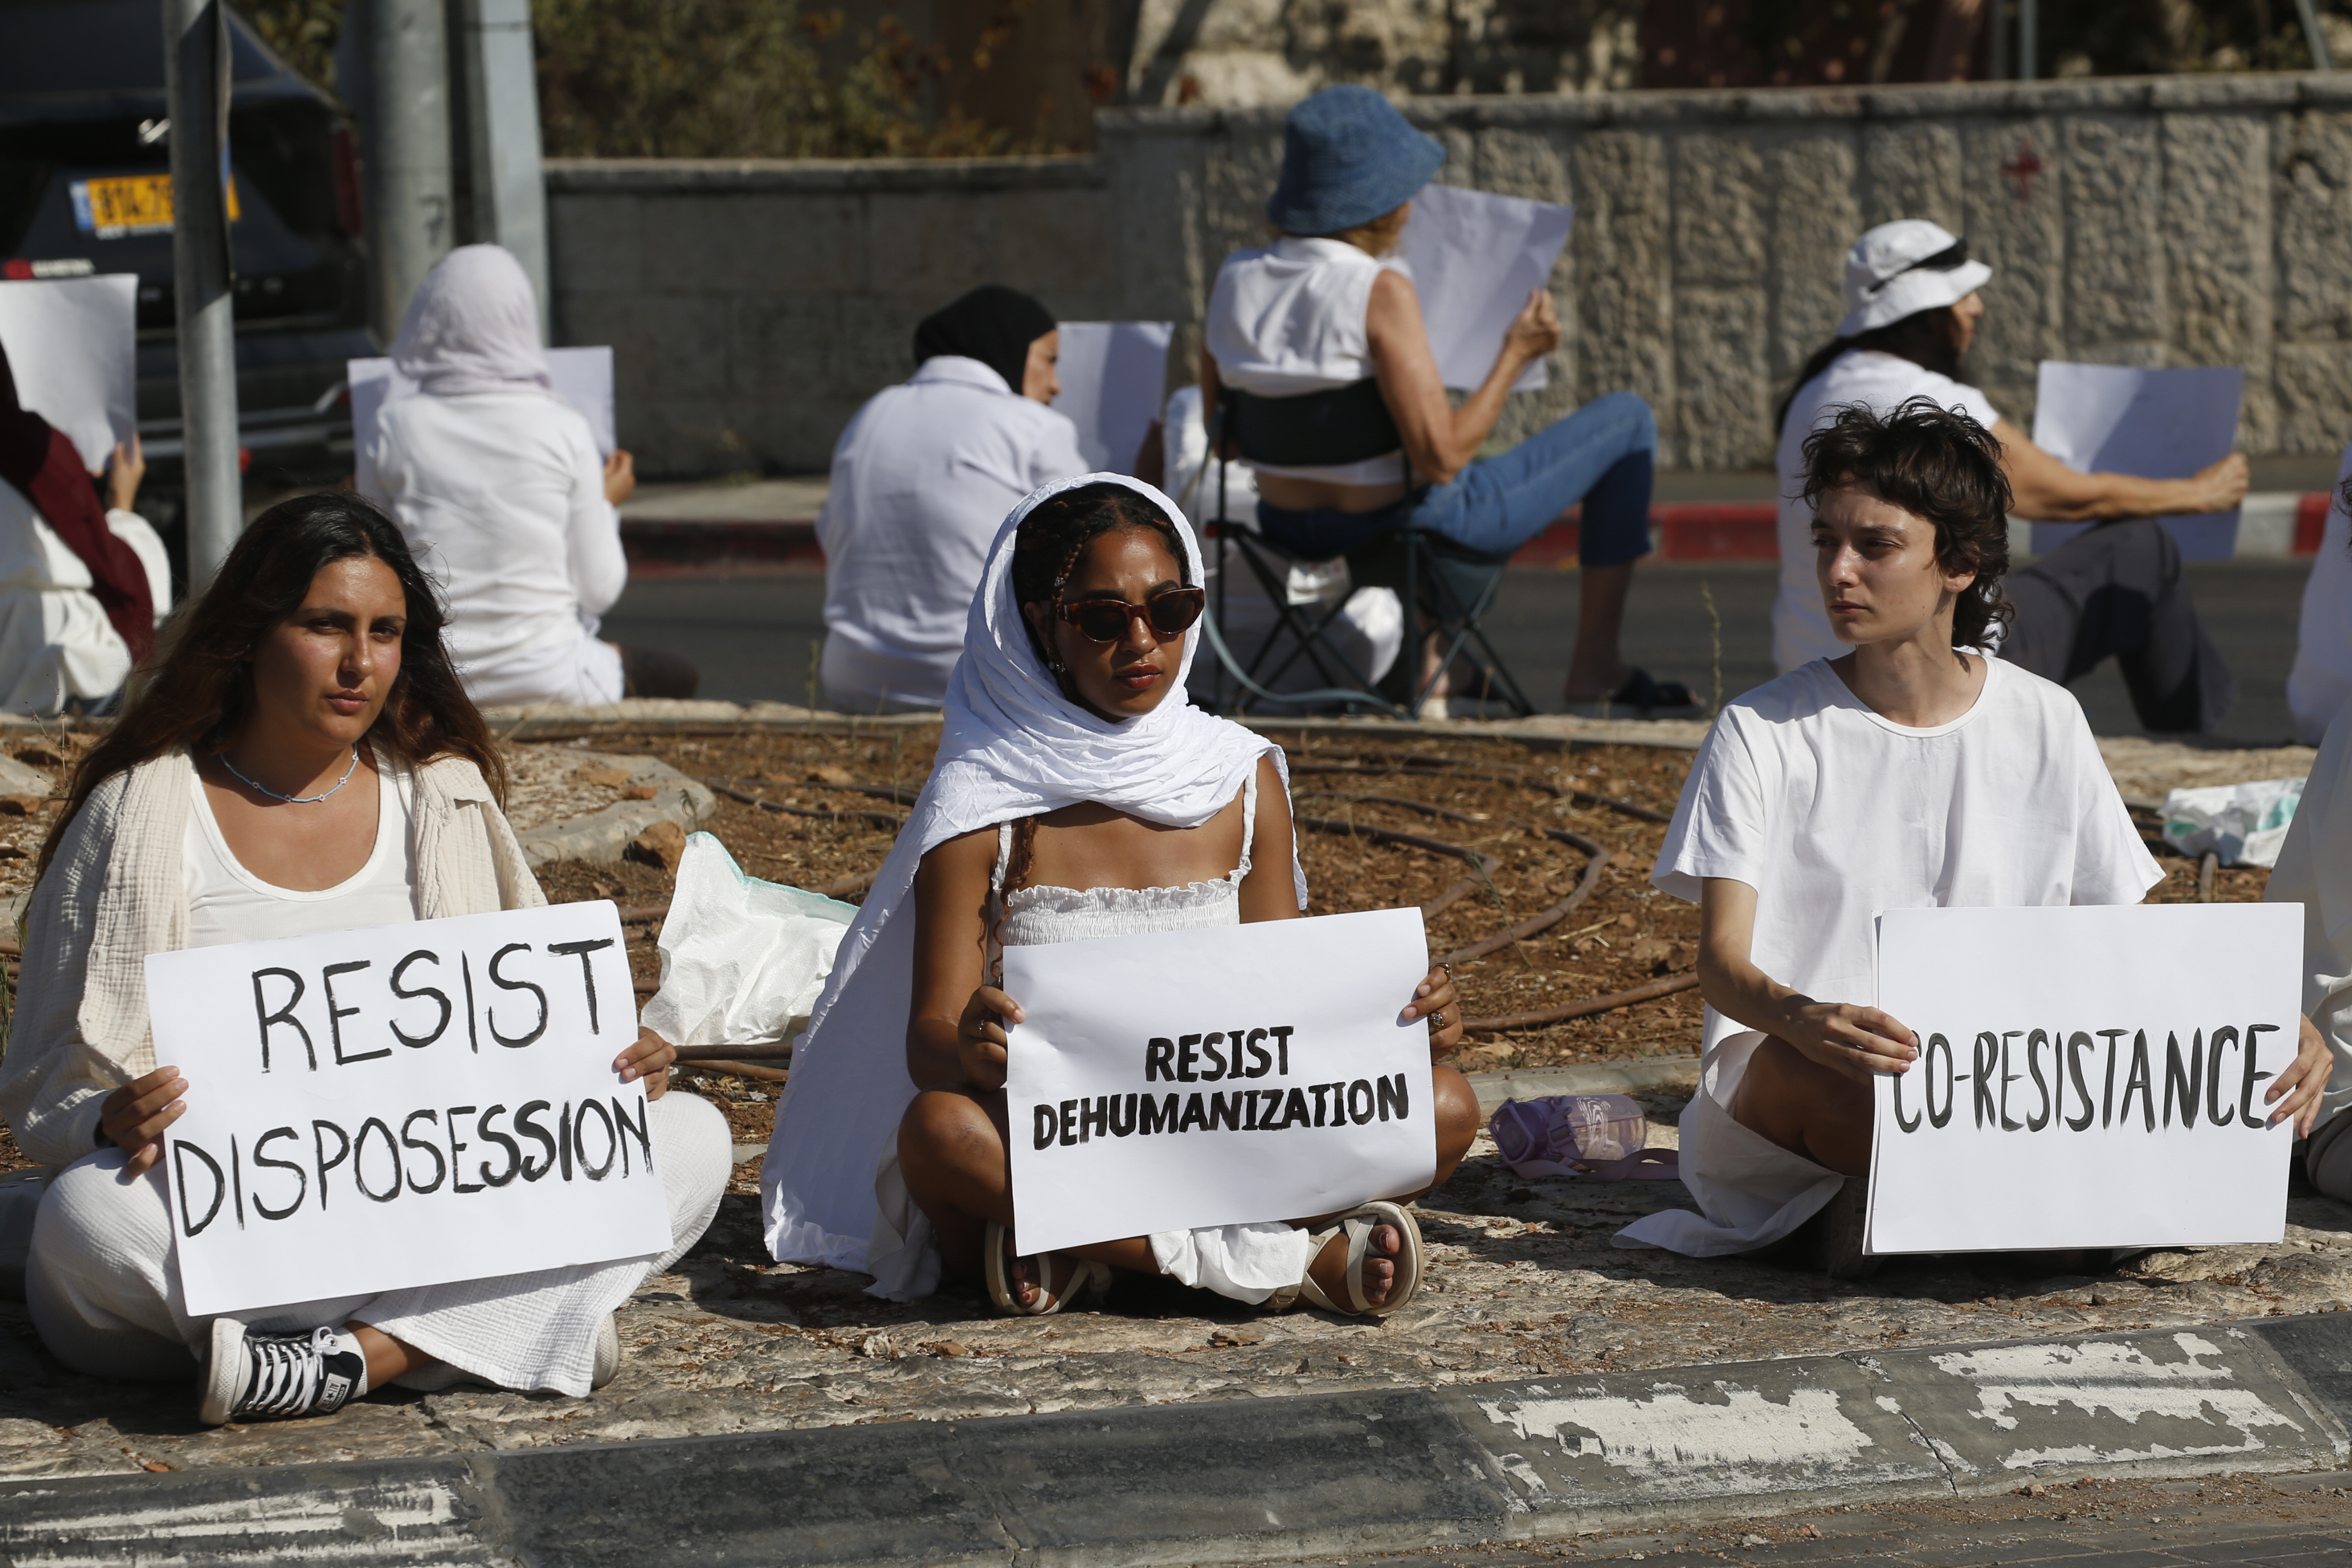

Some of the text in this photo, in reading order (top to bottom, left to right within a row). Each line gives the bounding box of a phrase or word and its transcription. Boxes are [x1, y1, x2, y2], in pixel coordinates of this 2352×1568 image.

[252, 938, 615, 1073] RESIST
[1145, 1025, 1294, 1083] RESIST
[1034, 1073, 1409, 1150] DEHUMANIZATION
[1893, 1023, 2281, 1135] CO-RESISTANCE
[174, 1094, 654, 1237] DISPOSESSION
